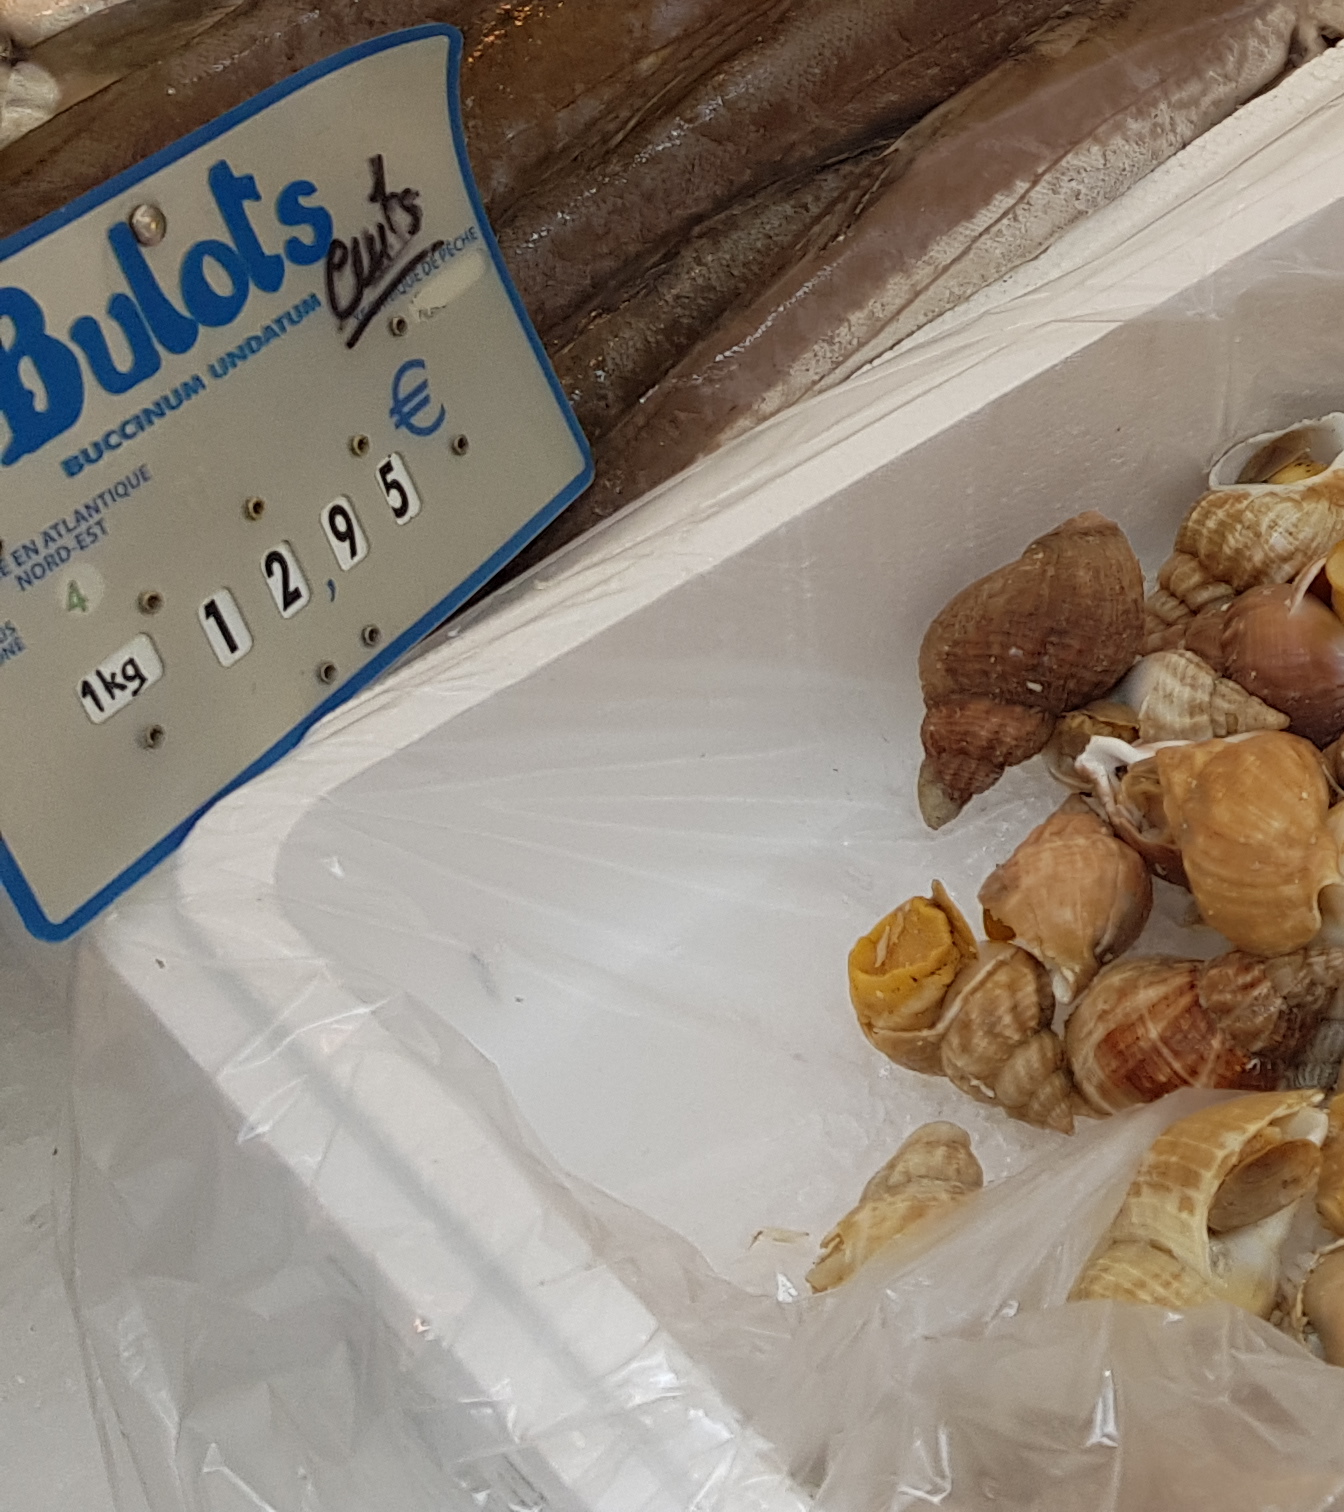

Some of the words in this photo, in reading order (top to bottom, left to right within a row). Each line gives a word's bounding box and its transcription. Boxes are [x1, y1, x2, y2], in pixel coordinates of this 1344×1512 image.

[0, 159, 334, 467] Bulots
[61, 374, 207, 478] BUCCINUM
[208, 292, 323, 380] UNDATUM
[10, 538, 40, 568] EN
[41, 464, 152, 550] ATLANTIQUE
[15, 517, 109, 592] NORD-EST
[79, 657, 148, 712] 1kg
[204, 460, 411, 655] 12,95
[389, 359, 445, 437] €
